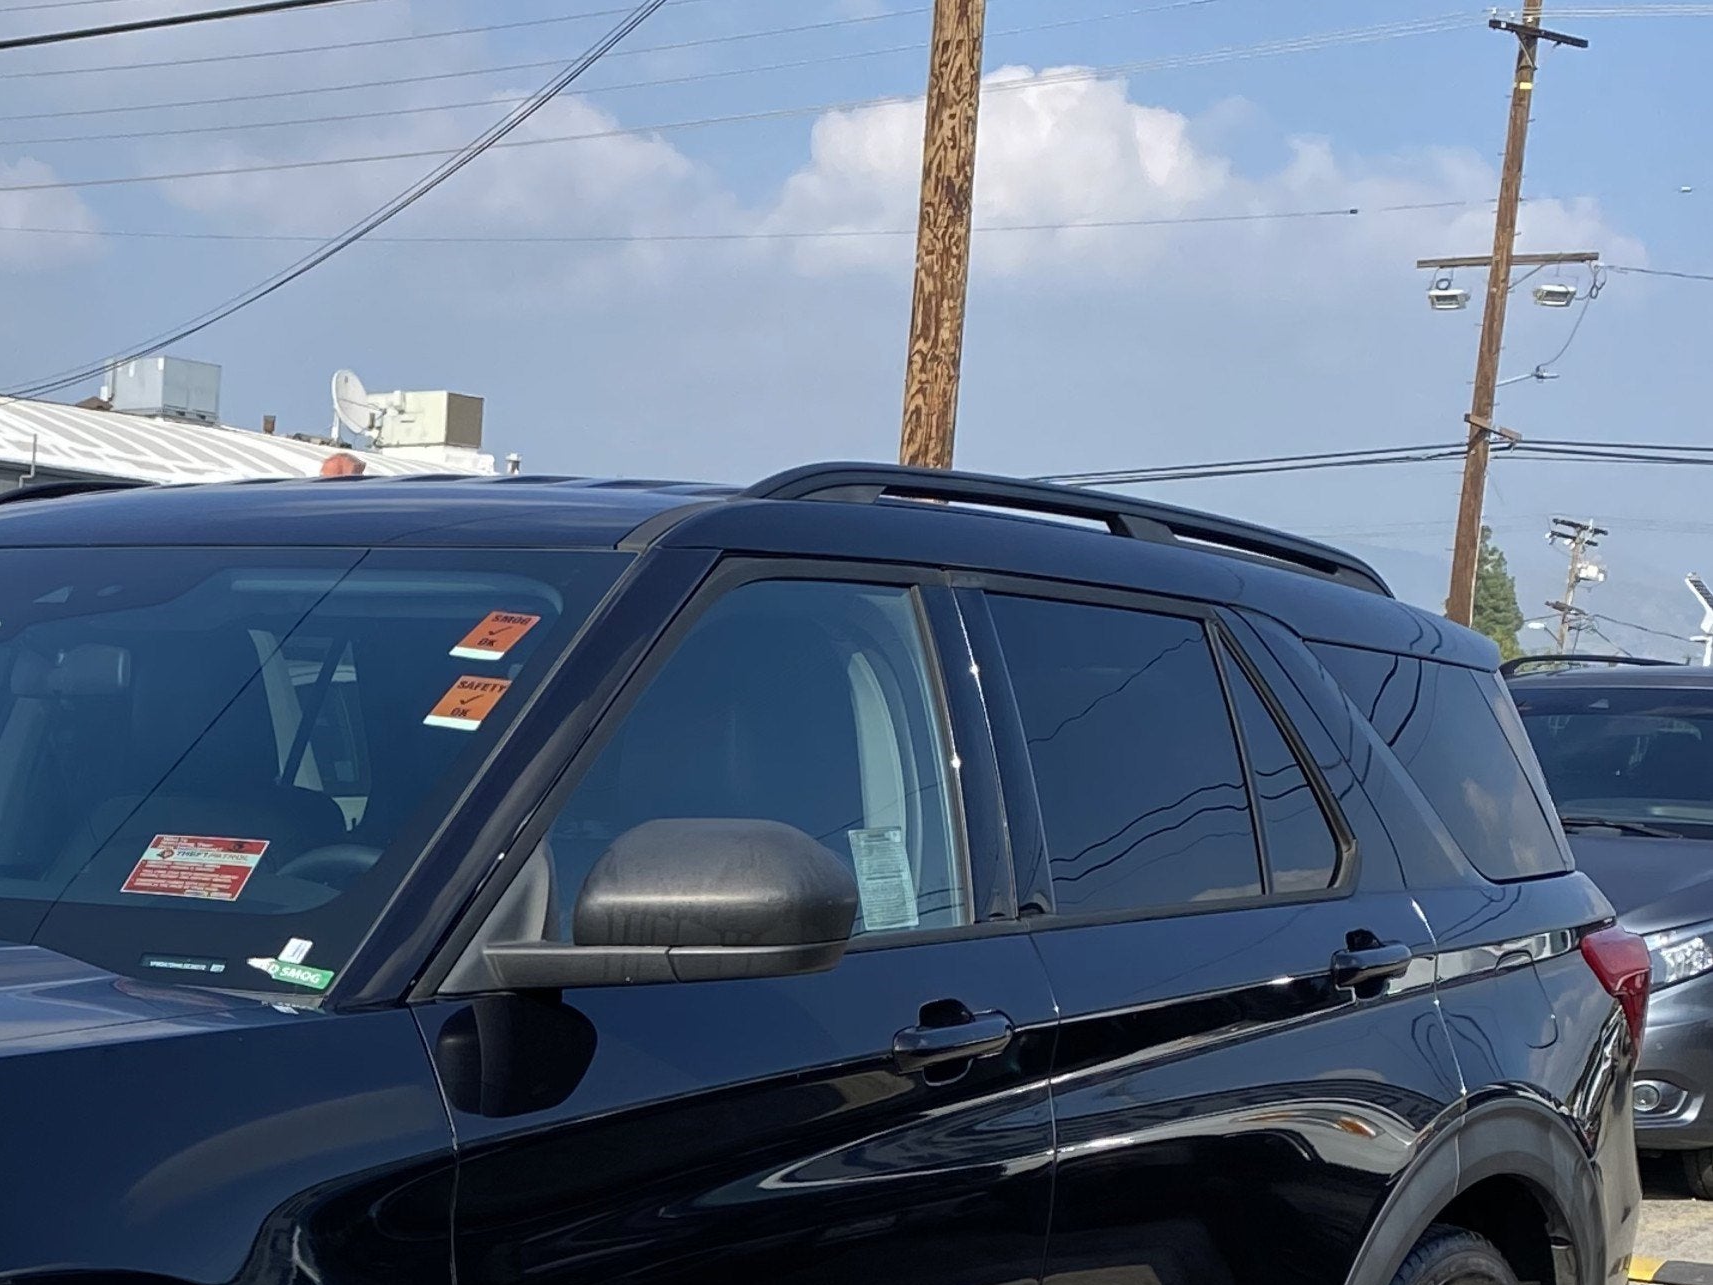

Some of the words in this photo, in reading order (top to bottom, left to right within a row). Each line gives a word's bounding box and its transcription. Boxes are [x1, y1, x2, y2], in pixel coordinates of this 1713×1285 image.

[492, 614, 531, 626] SMOG
[477, 638, 498, 647] OK
[457, 680, 507, 693] SAFETY
[451, 708, 471, 717] OK
[279, 966, 320, 984] SMOG
